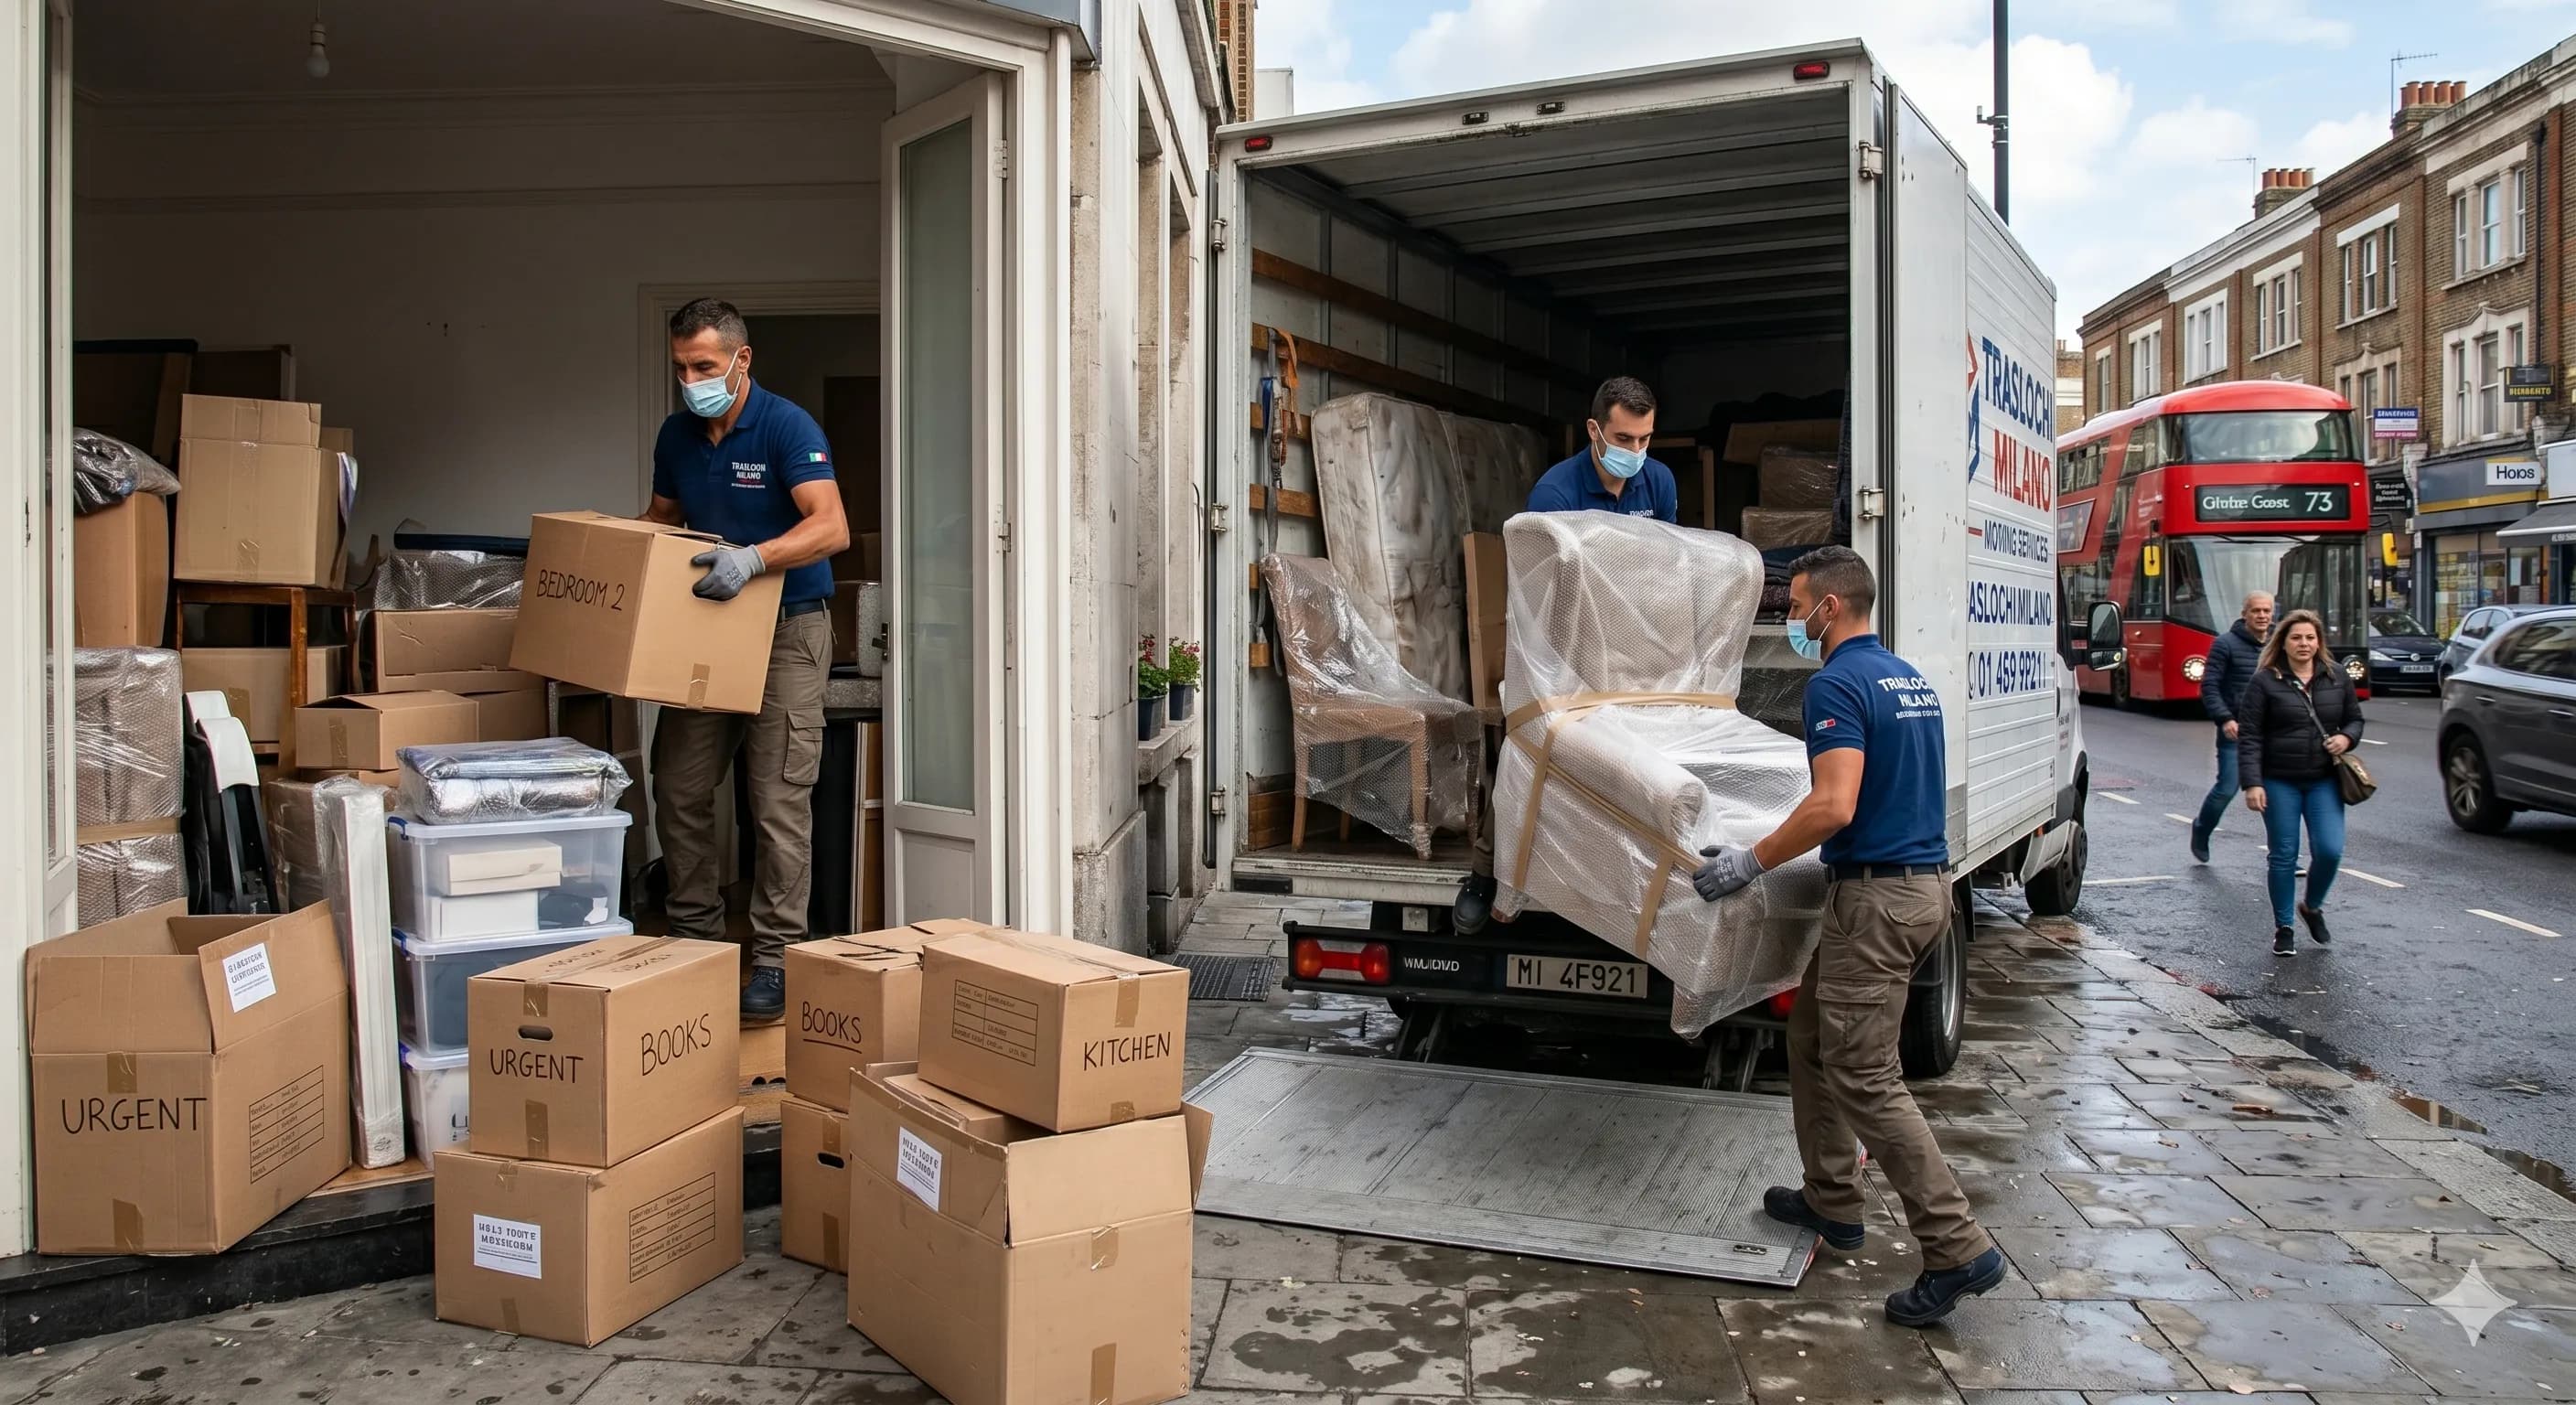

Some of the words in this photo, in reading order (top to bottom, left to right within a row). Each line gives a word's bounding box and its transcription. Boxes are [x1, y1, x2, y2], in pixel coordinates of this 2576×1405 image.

[1982, 336, 2053, 443] TRASLOCHI
[1994, 429, 2051, 512] MILANO
[2305, 491, 2334, 512] 73
[537, 569, 607, 607] BEDROOM
[611, 584, 625, 611] 2
[1978, 651, 1991, 697] 01
[1518, 958, 1541, 985] MI
[1560, 962, 1635, 993] 4F921
[802, 1001, 862, 1044] BOOKS
[490, 1048, 584, 1084] URGENT
[641, 1014, 711, 1076] BOOKS
[1084, 1031, 1170, 1071] KITCHEN
[61, 1098, 208, 1134] URGENT
